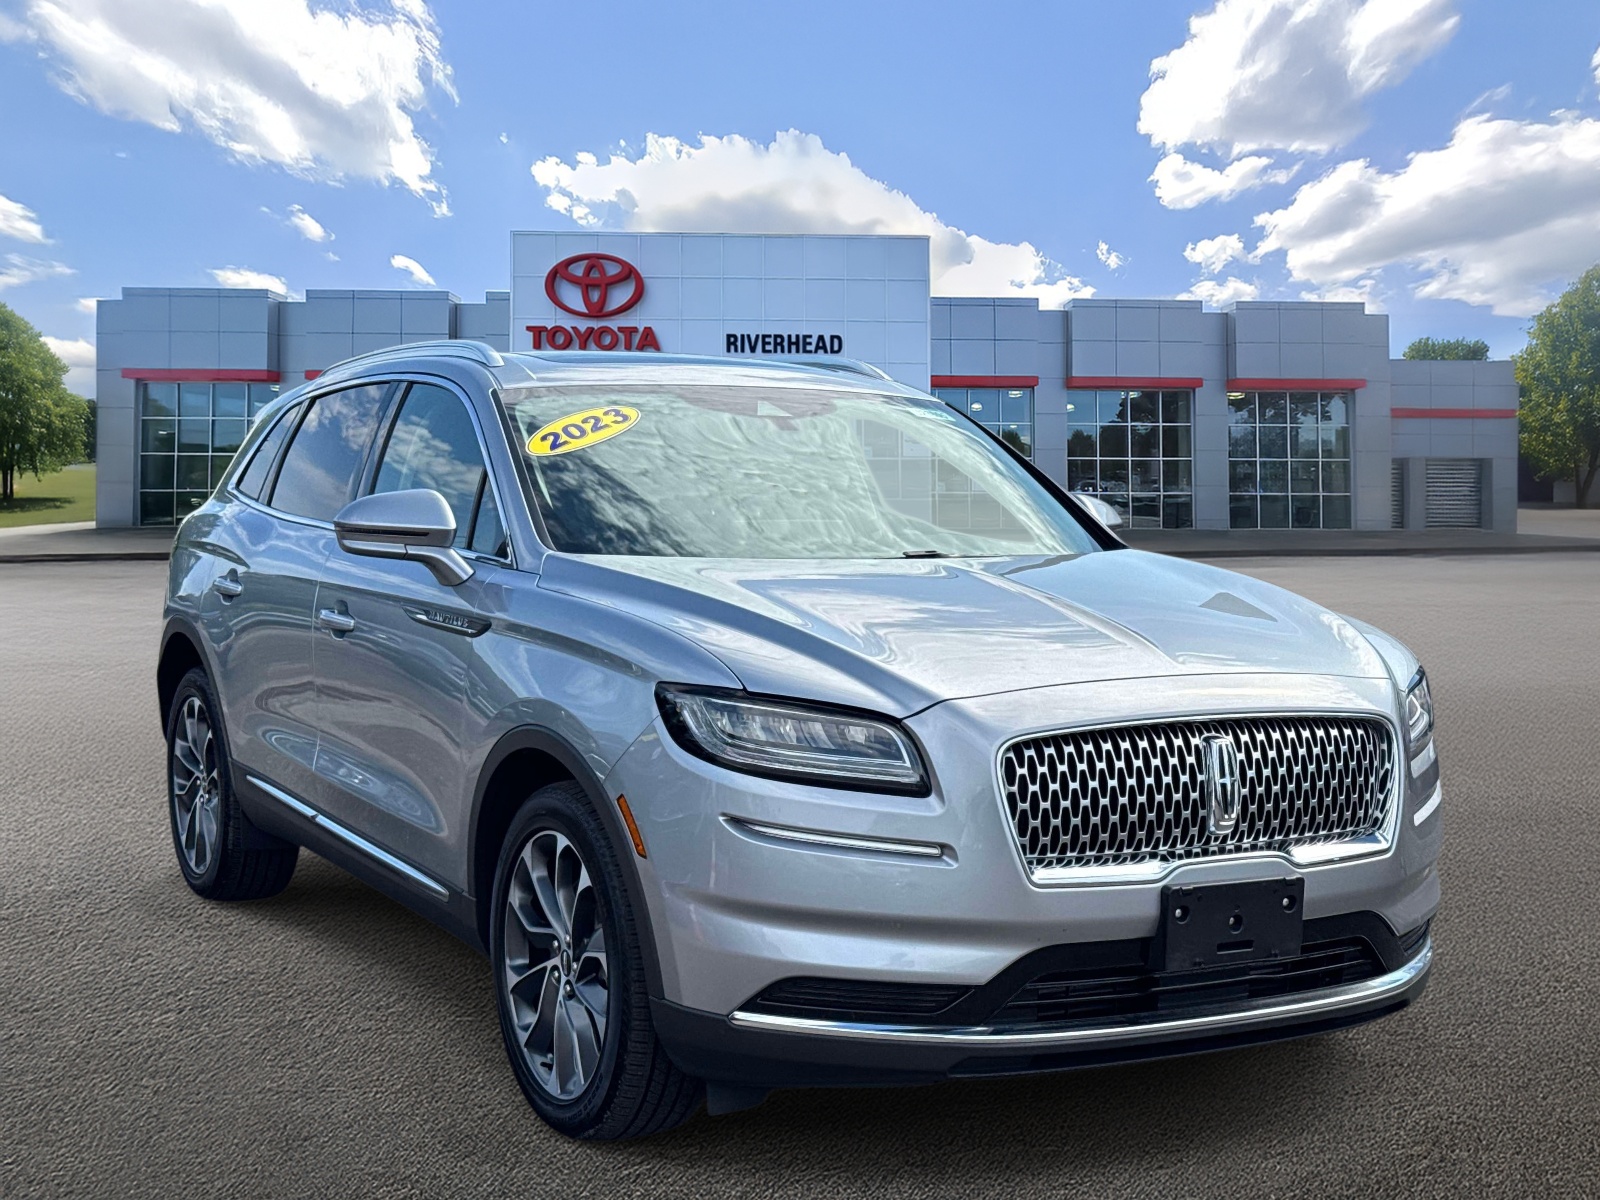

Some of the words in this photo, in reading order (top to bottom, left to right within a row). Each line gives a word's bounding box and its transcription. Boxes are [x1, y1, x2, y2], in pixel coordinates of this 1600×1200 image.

[526, 325, 661, 351] TOYOTA
[726, 333, 843, 354] RIVERHEAD
[540, 407, 631, 451] 2023
